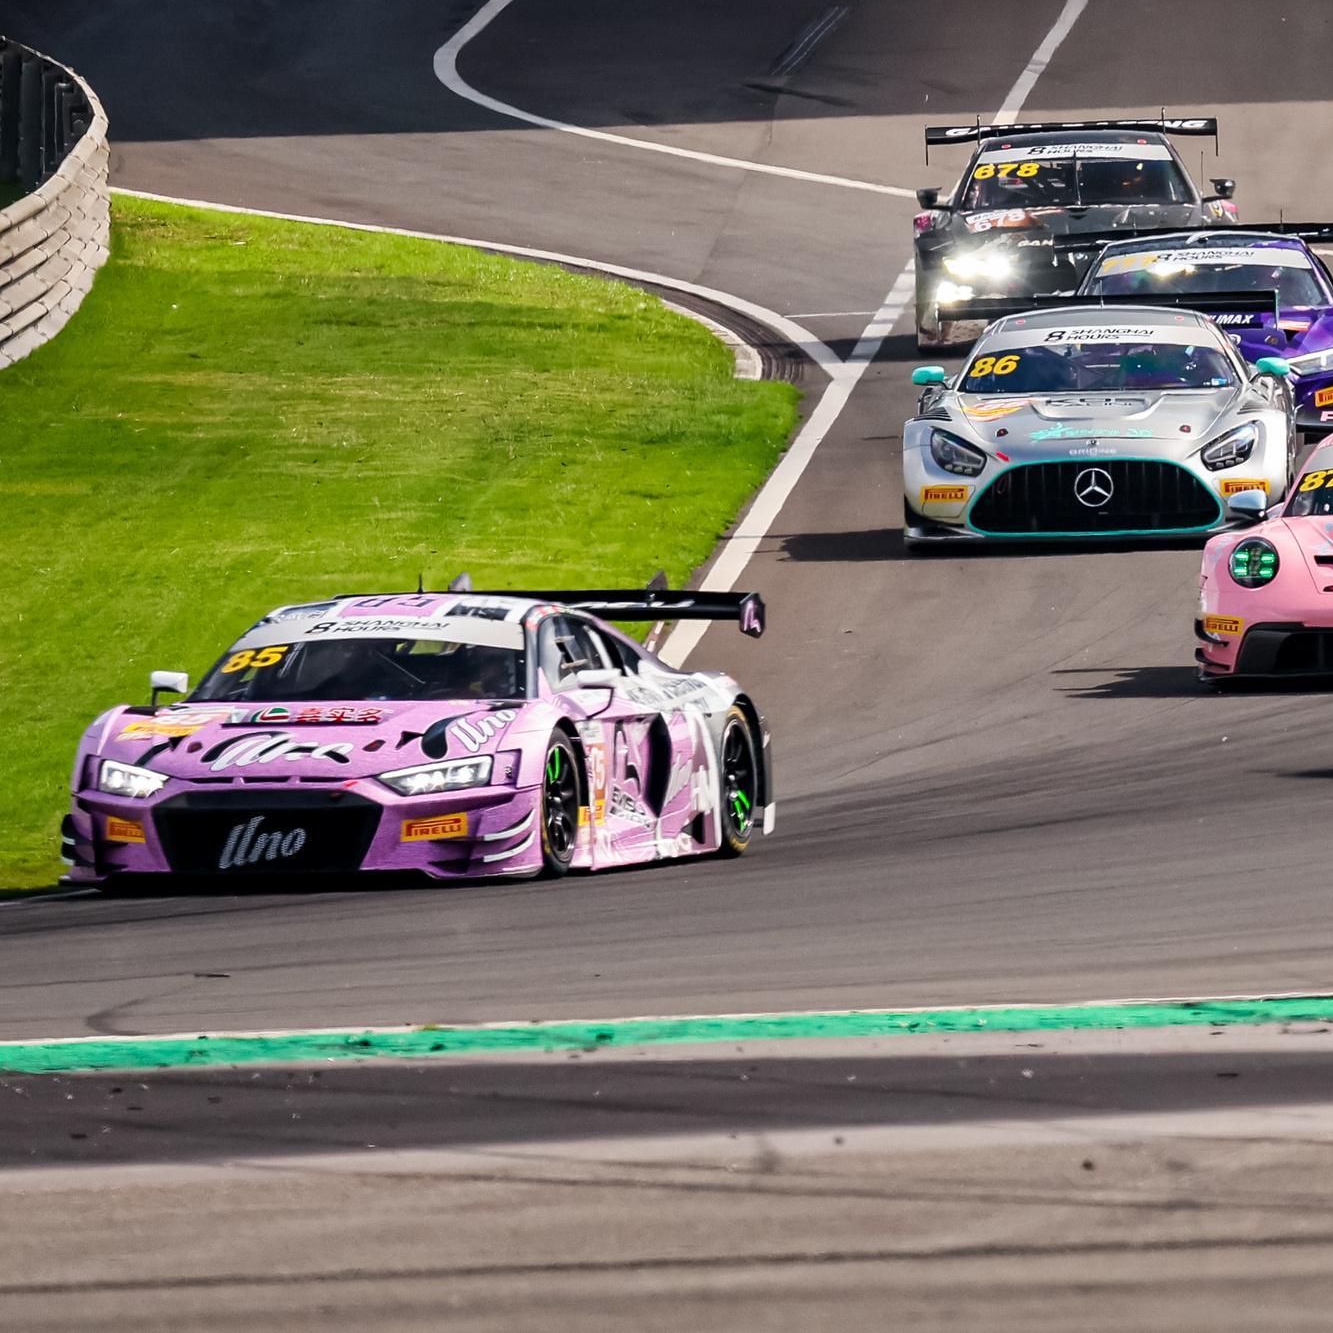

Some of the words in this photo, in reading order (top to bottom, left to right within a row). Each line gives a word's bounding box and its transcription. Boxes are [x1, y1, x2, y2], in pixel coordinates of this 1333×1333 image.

[973, 162, 1040, 180] 678
[1044, 330, 1067, 342] 8
[969, 354, 1021, 378] 86
[305, 622, 337, 634] 8
[343, 619, 450, 628] SHANGHAI
[333, 624, 401, 634] HOURS
[220, 646, 289, 674] 85
[405, 814, 464, 838] PIRELLI
